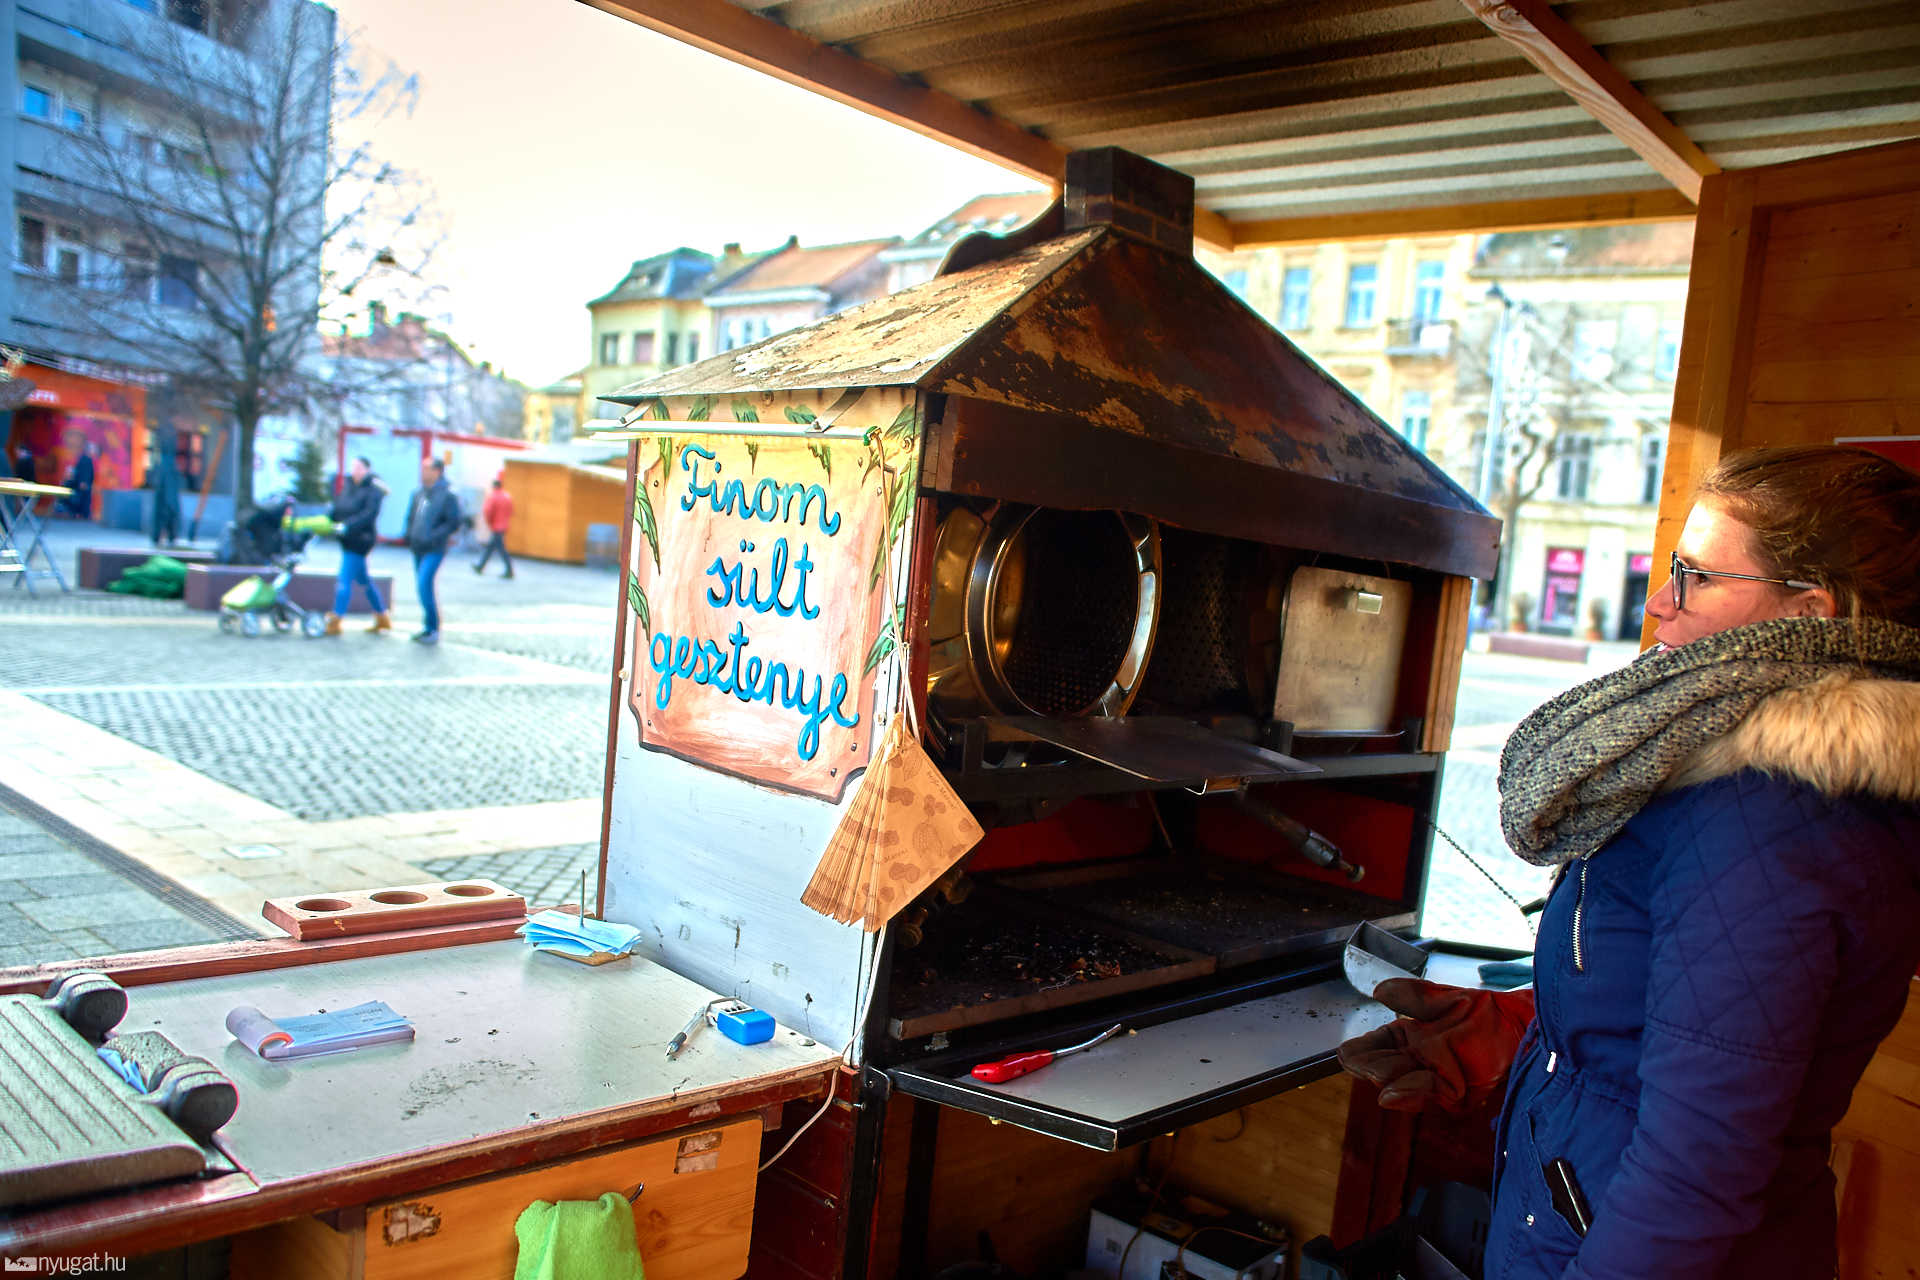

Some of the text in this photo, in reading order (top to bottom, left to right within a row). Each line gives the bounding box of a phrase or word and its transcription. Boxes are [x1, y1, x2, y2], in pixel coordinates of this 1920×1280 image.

[681, 444, 841, 535] Finom
[706, 537, 820, 620] sült
[650, 620, 859, 761] gesztenye
